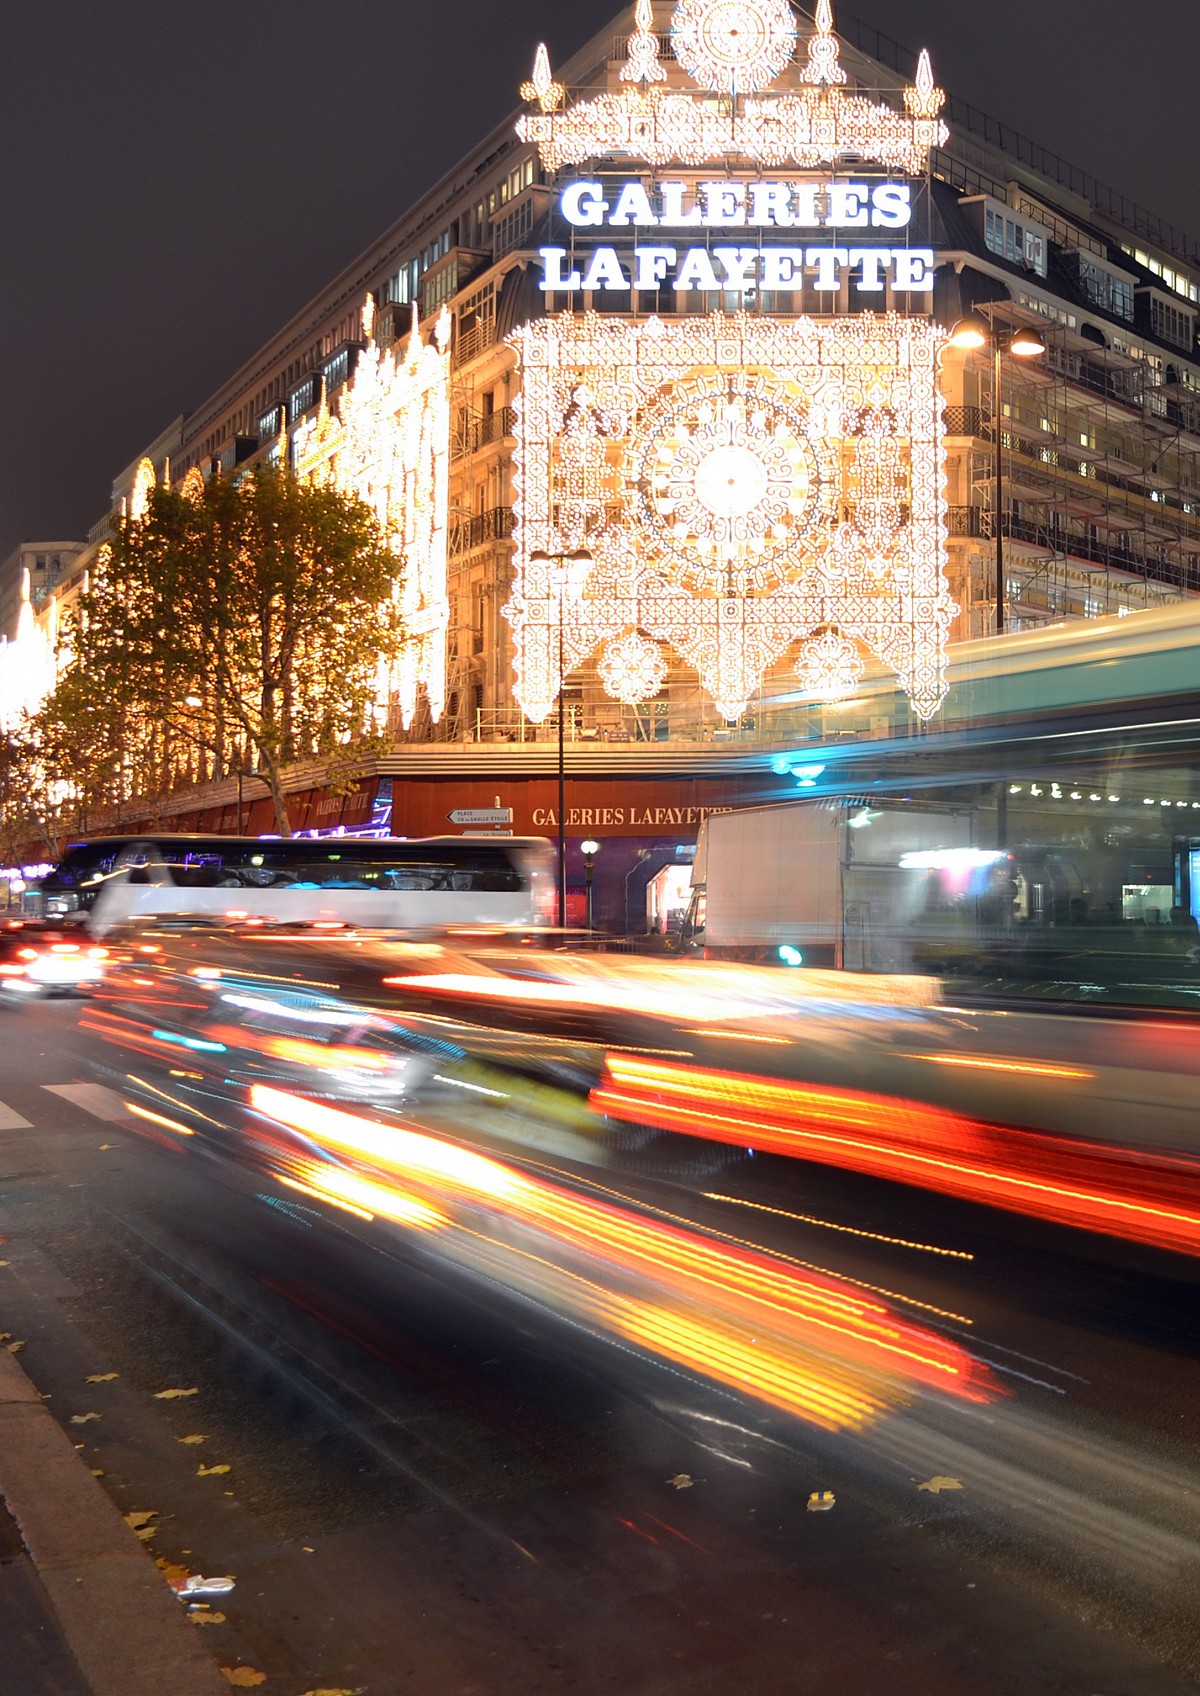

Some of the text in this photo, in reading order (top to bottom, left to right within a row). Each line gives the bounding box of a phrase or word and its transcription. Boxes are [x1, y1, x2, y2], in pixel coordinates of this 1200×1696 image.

[560, 182, 913, 228] GALERIES
[539, 248, 934, 292] LAFAYETTE
[629, 807, 733, 825] LAFAYET
